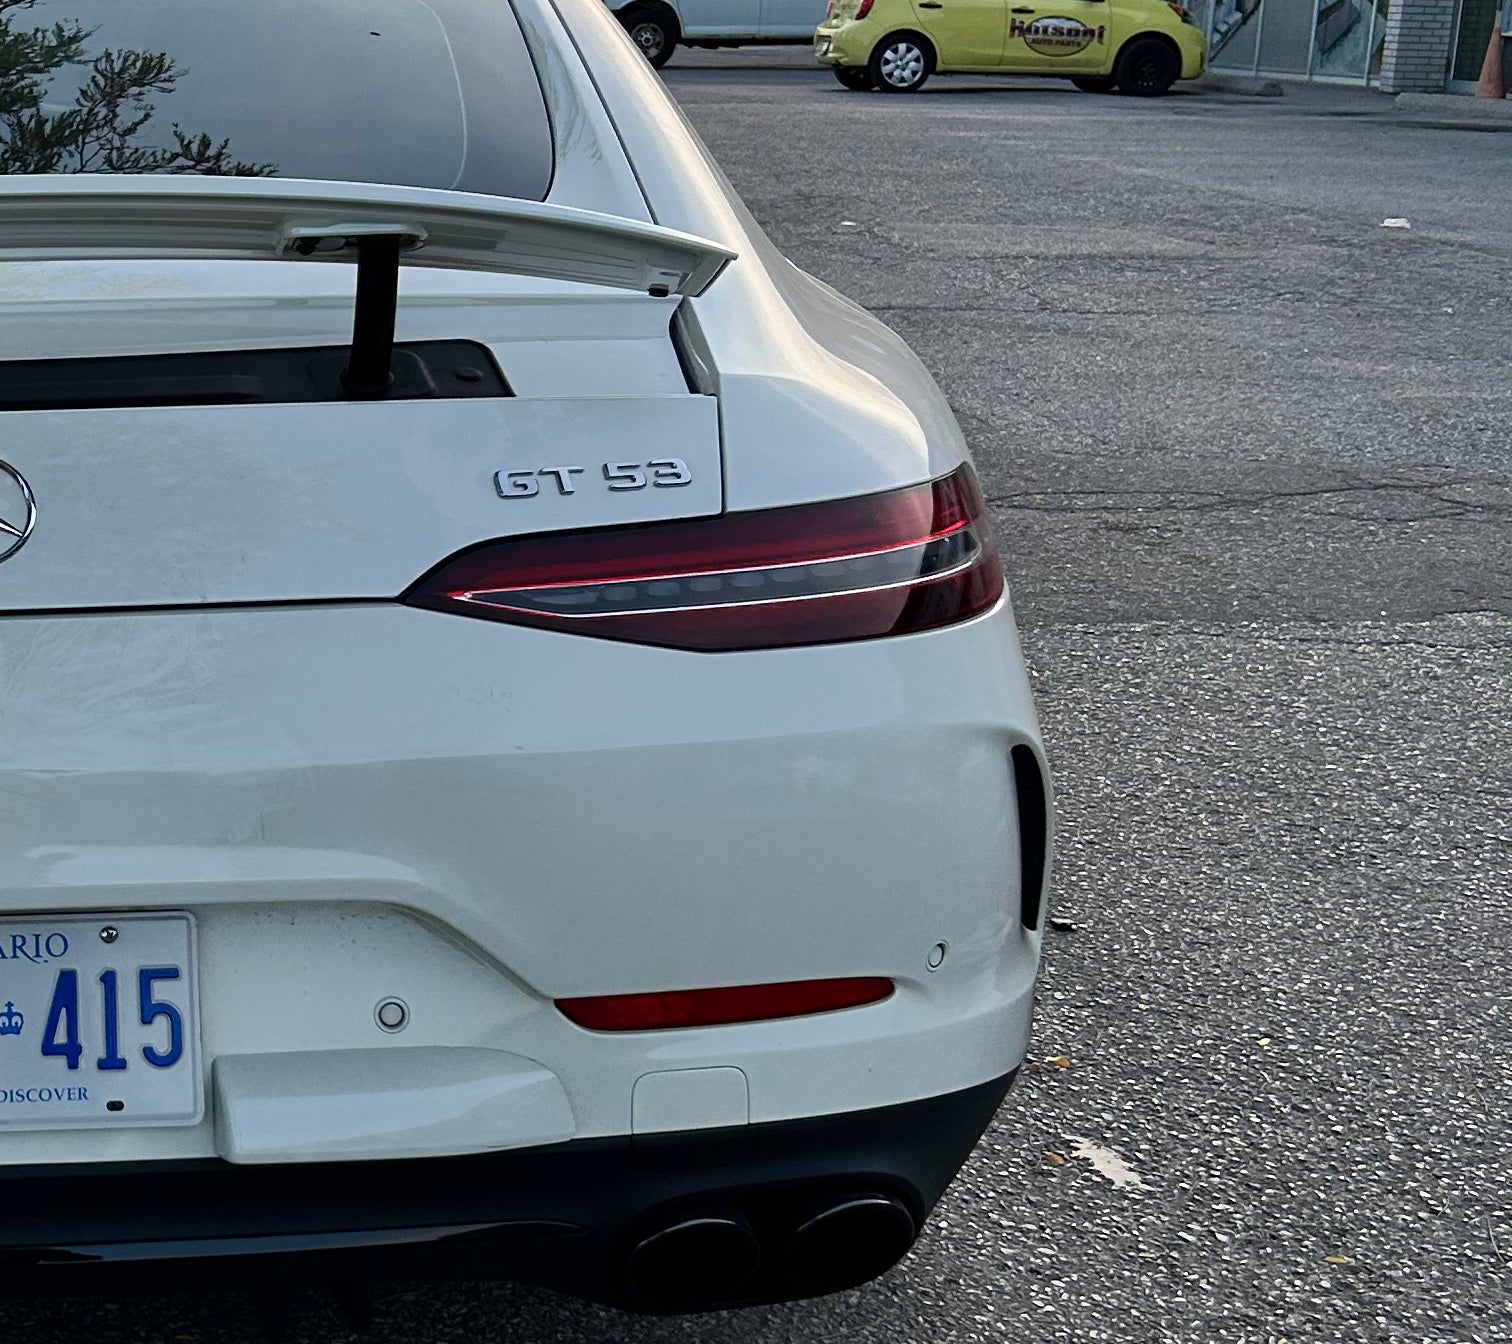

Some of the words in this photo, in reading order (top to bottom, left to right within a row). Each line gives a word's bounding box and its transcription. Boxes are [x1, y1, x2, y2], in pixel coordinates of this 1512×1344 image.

[493, 465, 585, 499] GT
[601, 457, 693, 491] 53
[41, 966, 184, 1071] 415
